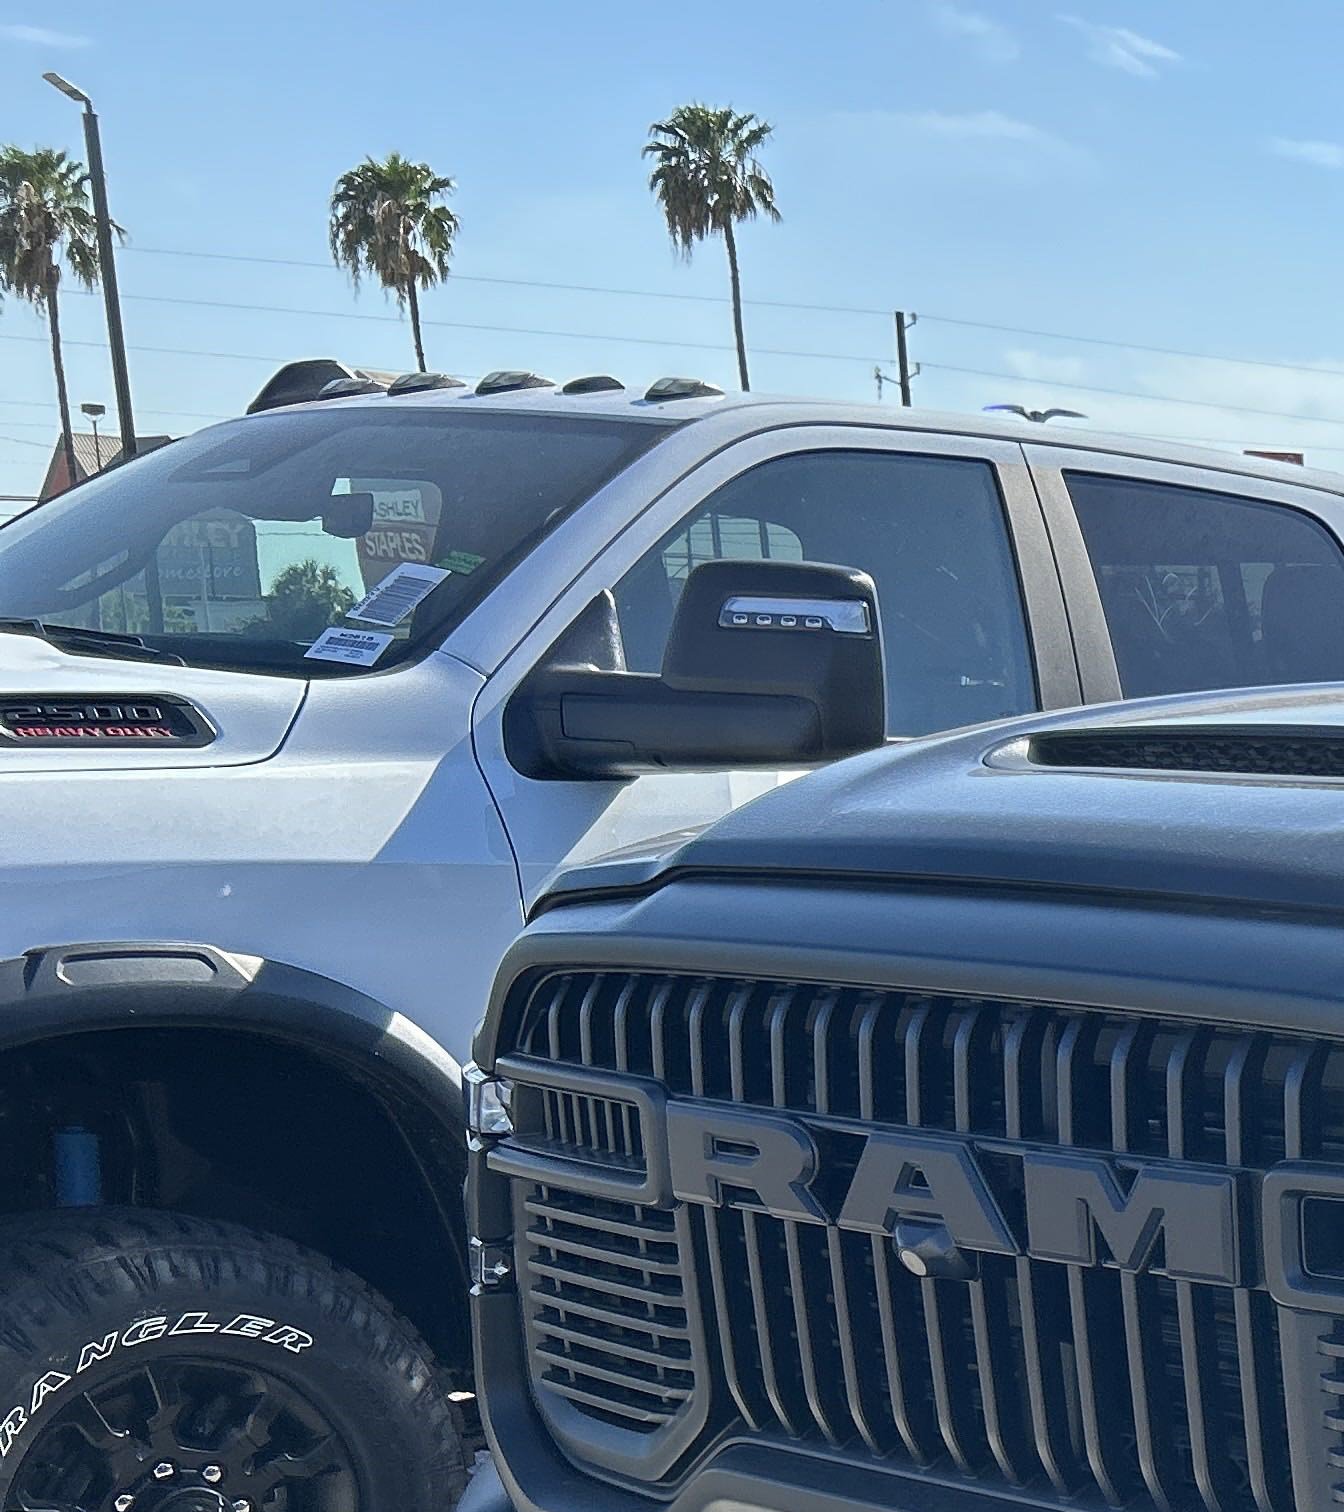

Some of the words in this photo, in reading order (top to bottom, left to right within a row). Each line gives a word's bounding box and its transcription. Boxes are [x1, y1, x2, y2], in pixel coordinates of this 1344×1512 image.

[373, 500, 419, 518] SHLEY
[365, 531, 426, 561] STAPLES
[2, 705, 163, 722] 2500
[14, 726, 100, 737] HEAVY
[664, 1098, 1241, 1287] RAM
